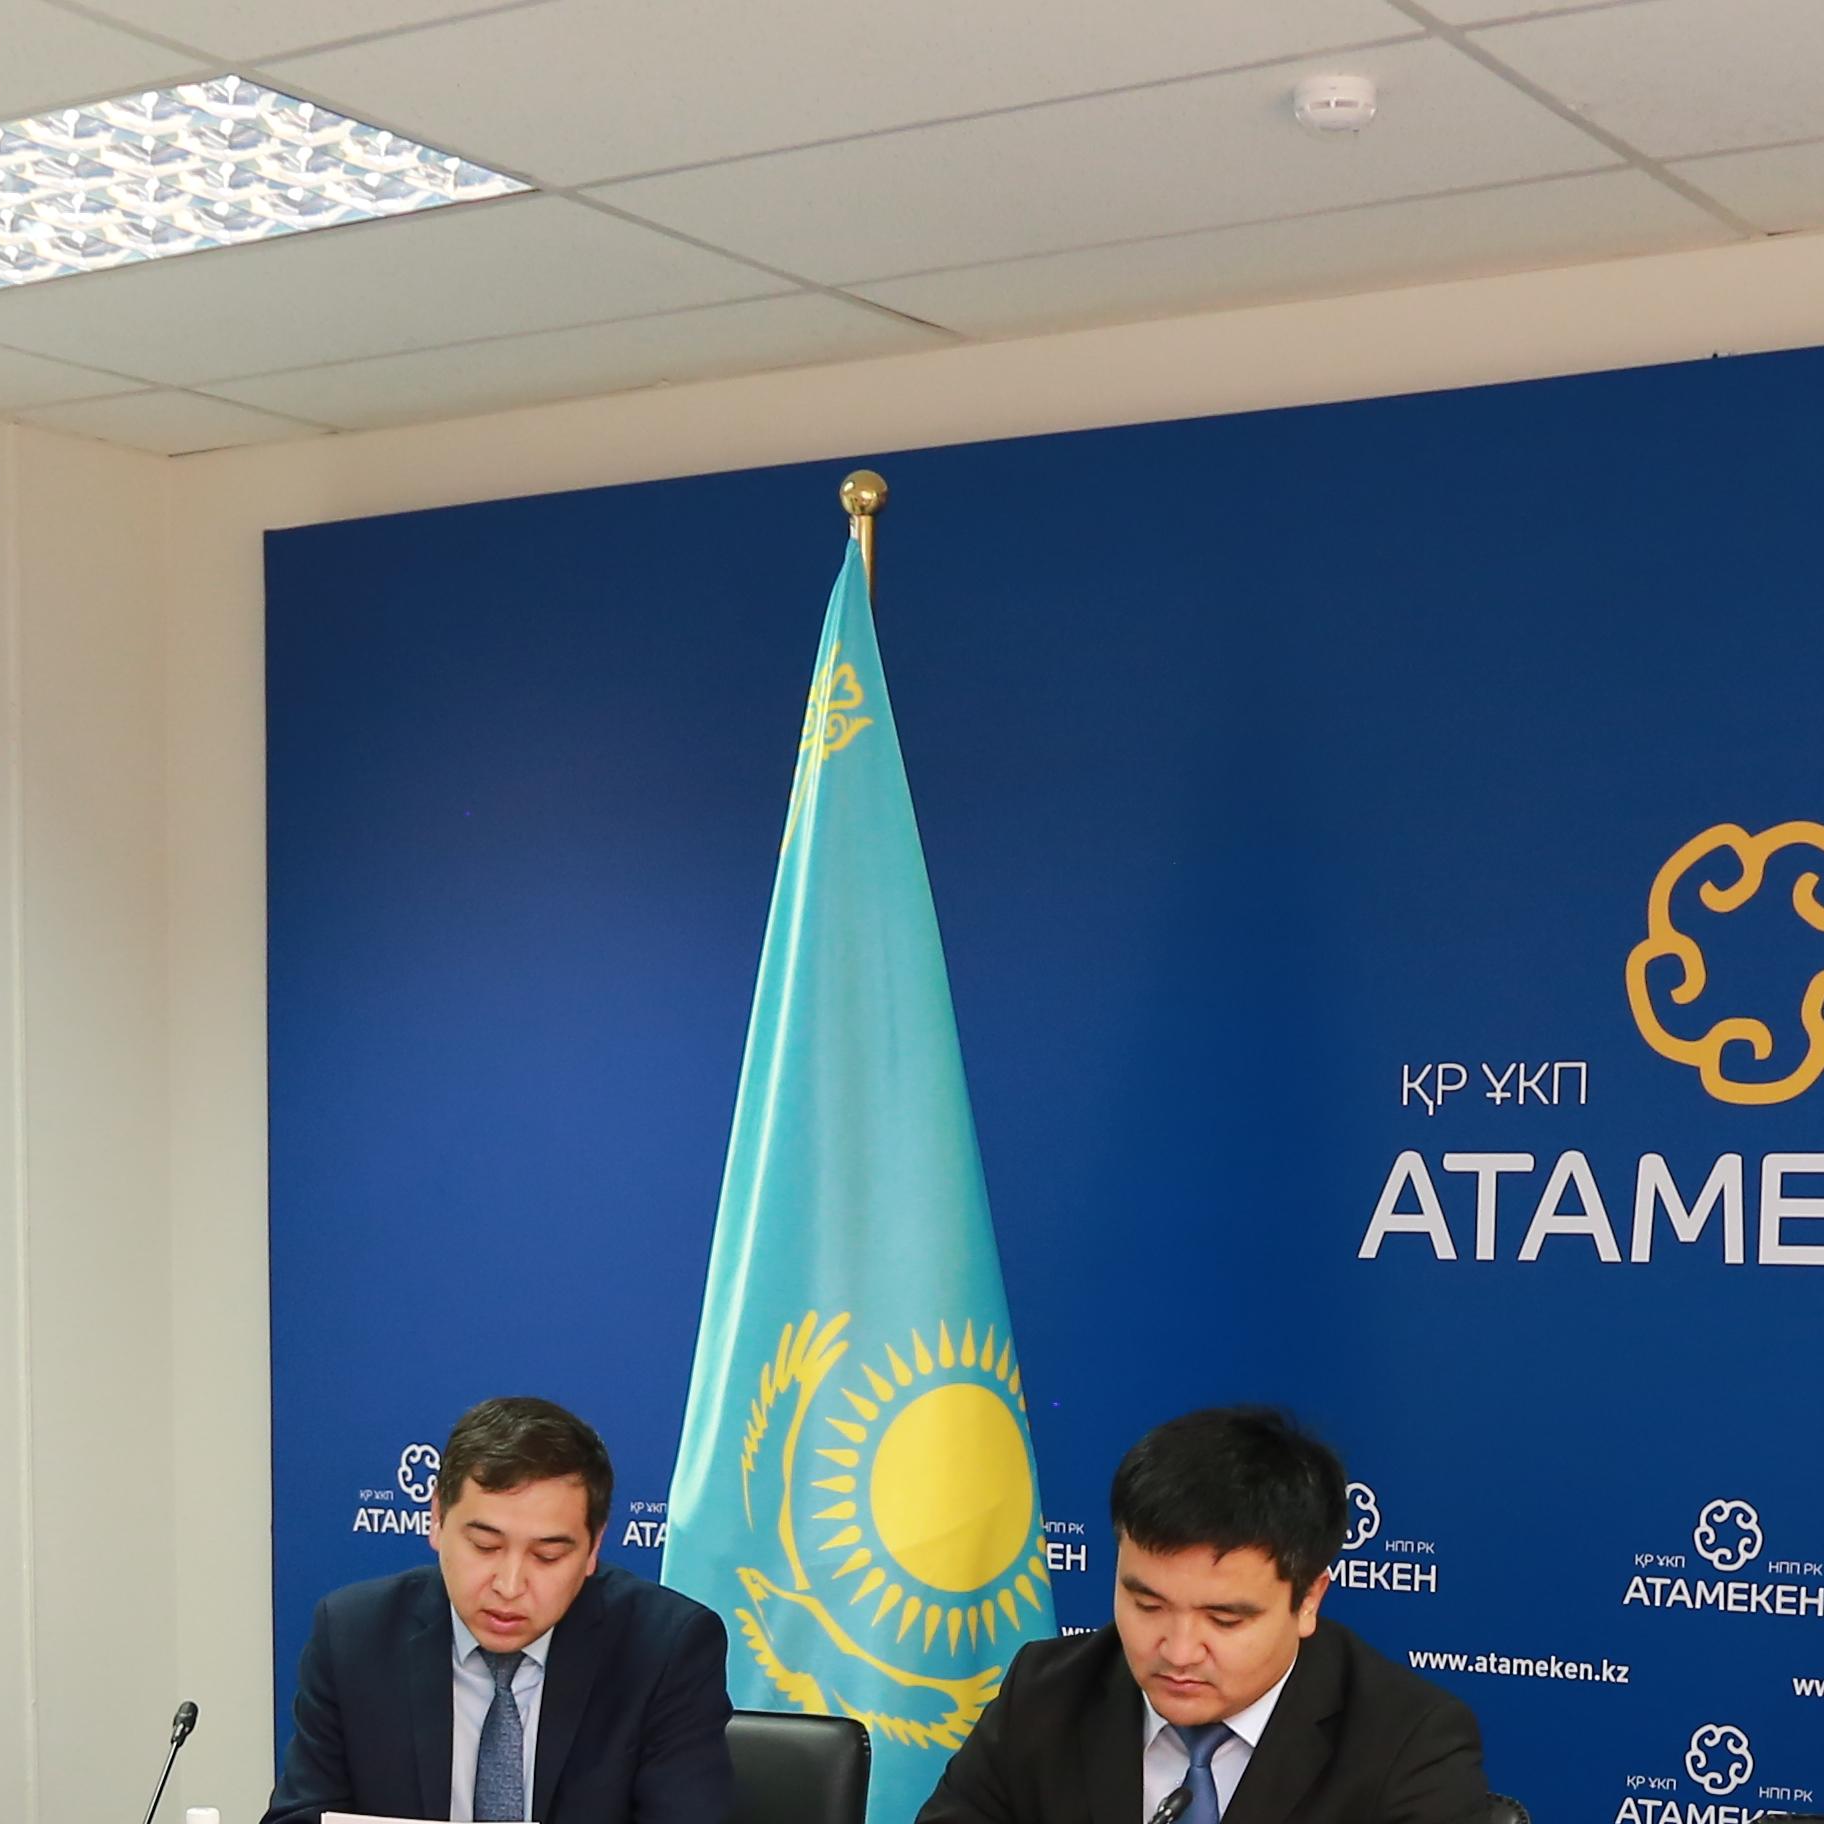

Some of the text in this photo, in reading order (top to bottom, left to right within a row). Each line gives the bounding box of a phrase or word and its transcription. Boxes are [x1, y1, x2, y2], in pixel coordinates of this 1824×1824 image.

[1401, 1061, 1589, 1116] ҚР ҰКП
[353, 1507, 432, 1536] АТАМЕ
[1068, 1521, 1085, 1535] РК
[1385, 1539, 1435, 1554] НПП РК
[1327, 1559, 1438, 1593] МЕКЕН
[1768, 1560, 1824, 1576] НПП РК
[1408, 1650, 1630, 1684] www.atameken.kz
[1758, 1786, 1814, 1803] НПП РК
